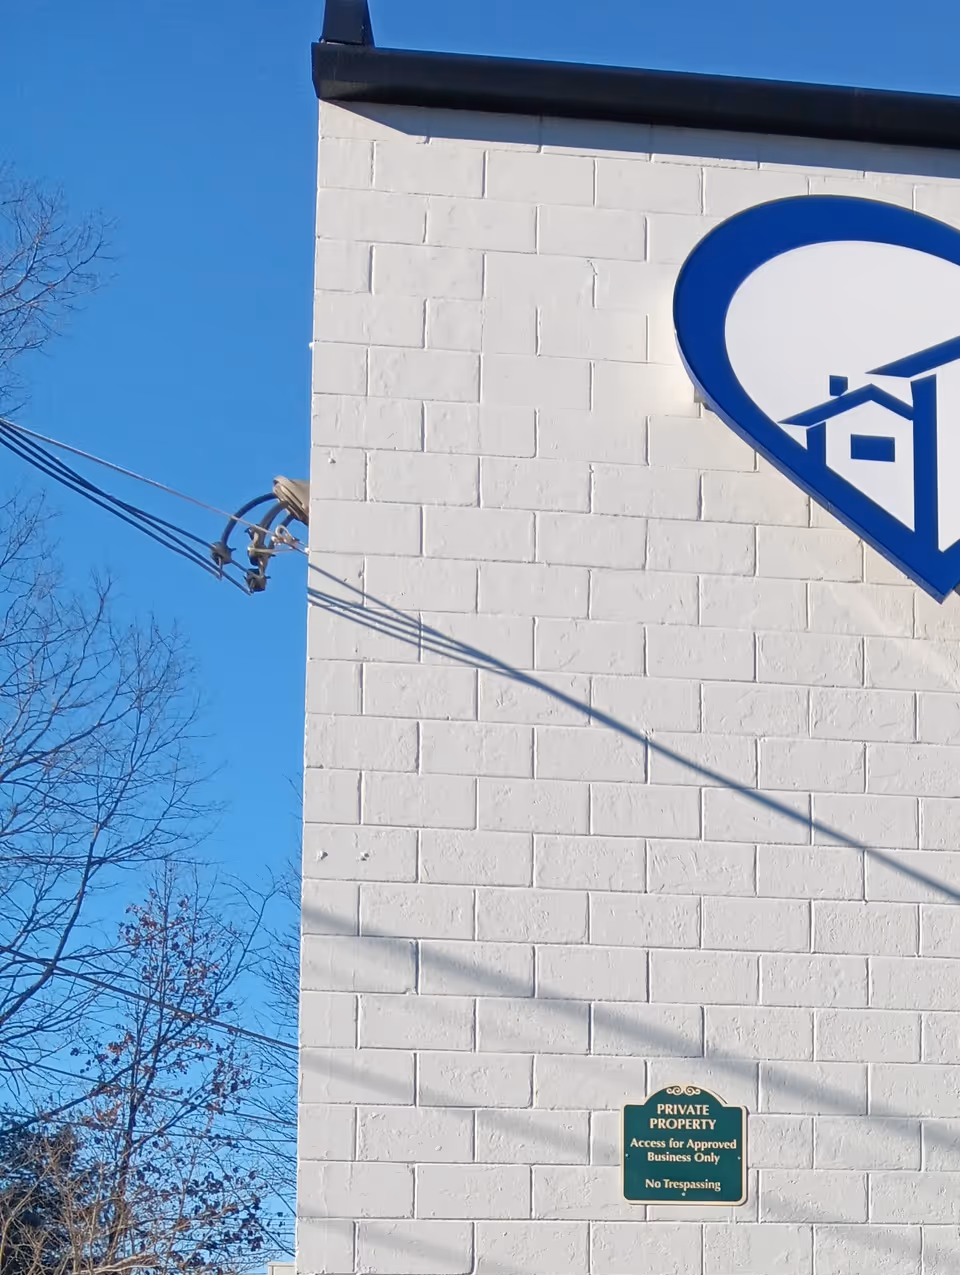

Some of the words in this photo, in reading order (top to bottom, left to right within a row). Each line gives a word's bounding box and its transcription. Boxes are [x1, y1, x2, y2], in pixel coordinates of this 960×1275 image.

[656, 1103, 710, 1116] PRIVATE
[649, 1118, 717, 1130] PROPERTY
[630, 1138, 666, 1148] Access
[669, 1138, 684, 1149] for
[686, 1139, 737, 1151] Approved
[647, 1152, 692, 1163] Business
[694, 1152, 720, 1165] Only
[645, 1179, 662, 1189] No
[662, 1178, 721, 1192] Trespassing
